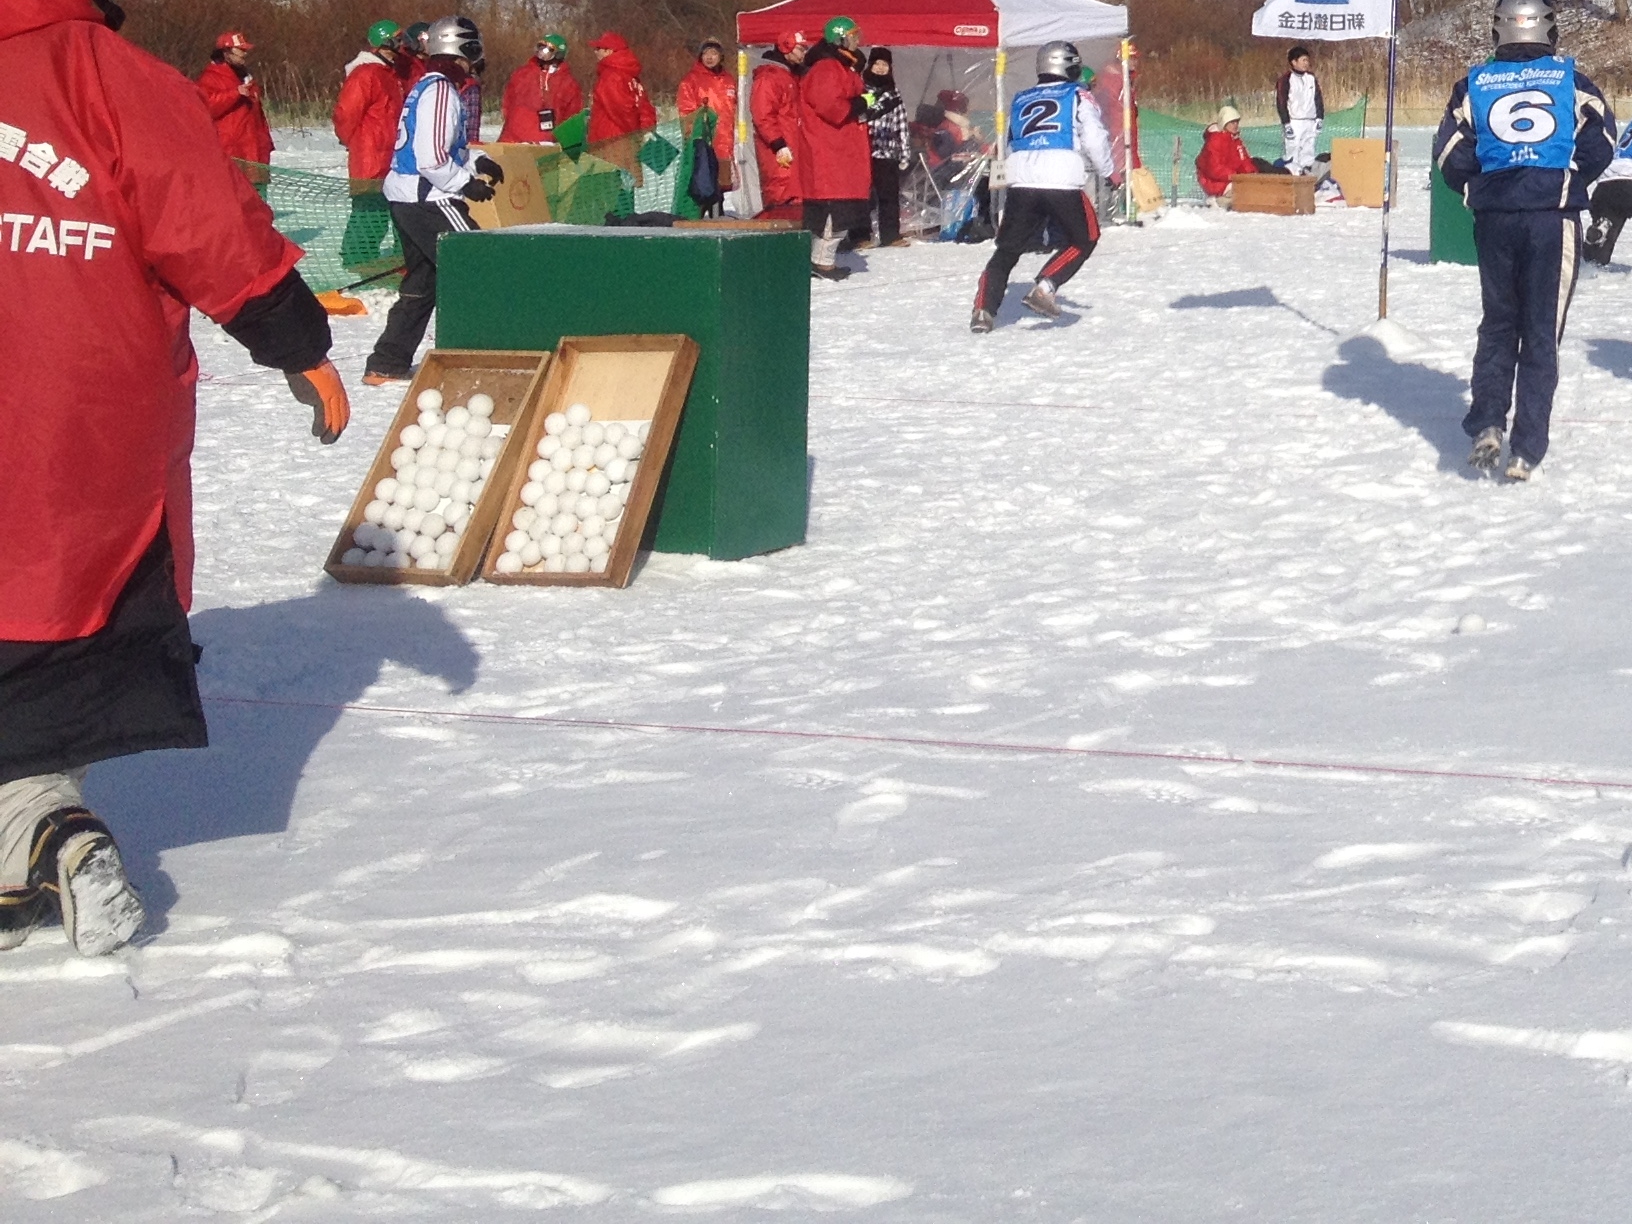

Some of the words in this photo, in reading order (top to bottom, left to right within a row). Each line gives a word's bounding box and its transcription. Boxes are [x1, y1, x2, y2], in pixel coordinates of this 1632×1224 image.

[1019, 98, 1061, 138] 2
[1487, 89, 1557, 145] 6
[0, 212, 116, 260] TAFF
